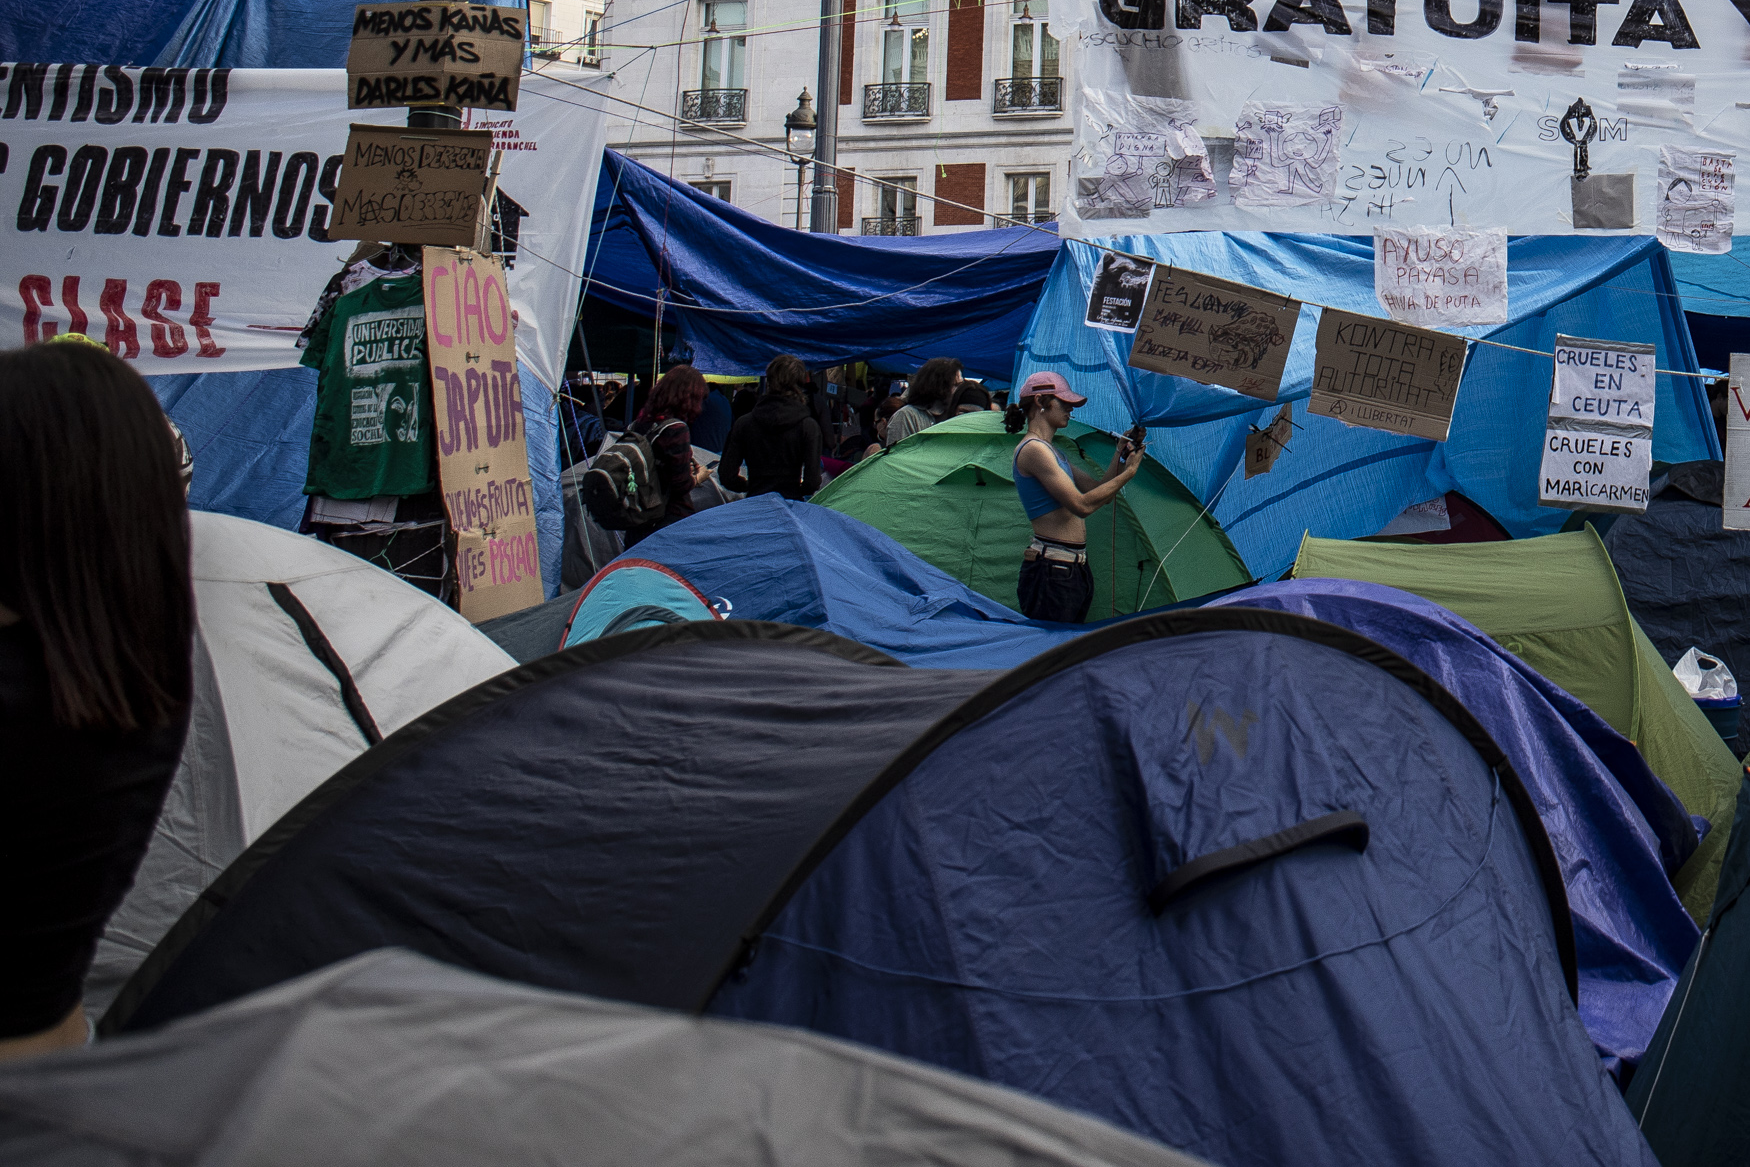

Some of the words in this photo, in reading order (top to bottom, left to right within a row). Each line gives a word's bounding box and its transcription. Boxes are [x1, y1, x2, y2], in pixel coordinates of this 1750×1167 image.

[353, 7, 432, 35] MENOS
[439, 6, 523, 40] KAÑAS
[389, 38, 410, 66] Y
[411, 34, 481, 64] MÁS
[0, 63, 234, 125] NTISMO
[355, 75, 444, 106] DARLES
[444, 72, 513, 111] KAÑA
[474, 119, 514, 130] SINDICATO
[353, 142, 416, 168] MENOS
[16, 144, 346, 243] GOBIERNOS
[1383, 237, 1465, 265] AYUSO
[1396, 266, 1479, 286] PAYASA
[1154, 280, 1188, 305] FES
[1425, 295, 1440, 310] DE
[1445, 295, 1481, 310] PUTA
[1335, 321, 1436, 361] KONTRA
[1350, 349, 1416, 384] TOTA
[1594, 372, 1623, 391] EN
[435, 360, 526, 457] JAPUTA
[1357, 405, 1416, 429] LLIBERTAT
[1572, 396, 1642, 419] CEUTA
[1549, 436, 1633, 458] CRUELES
[1573, 460, 1604, 475] CON
[487, 477, 530, 522] FRUTA
